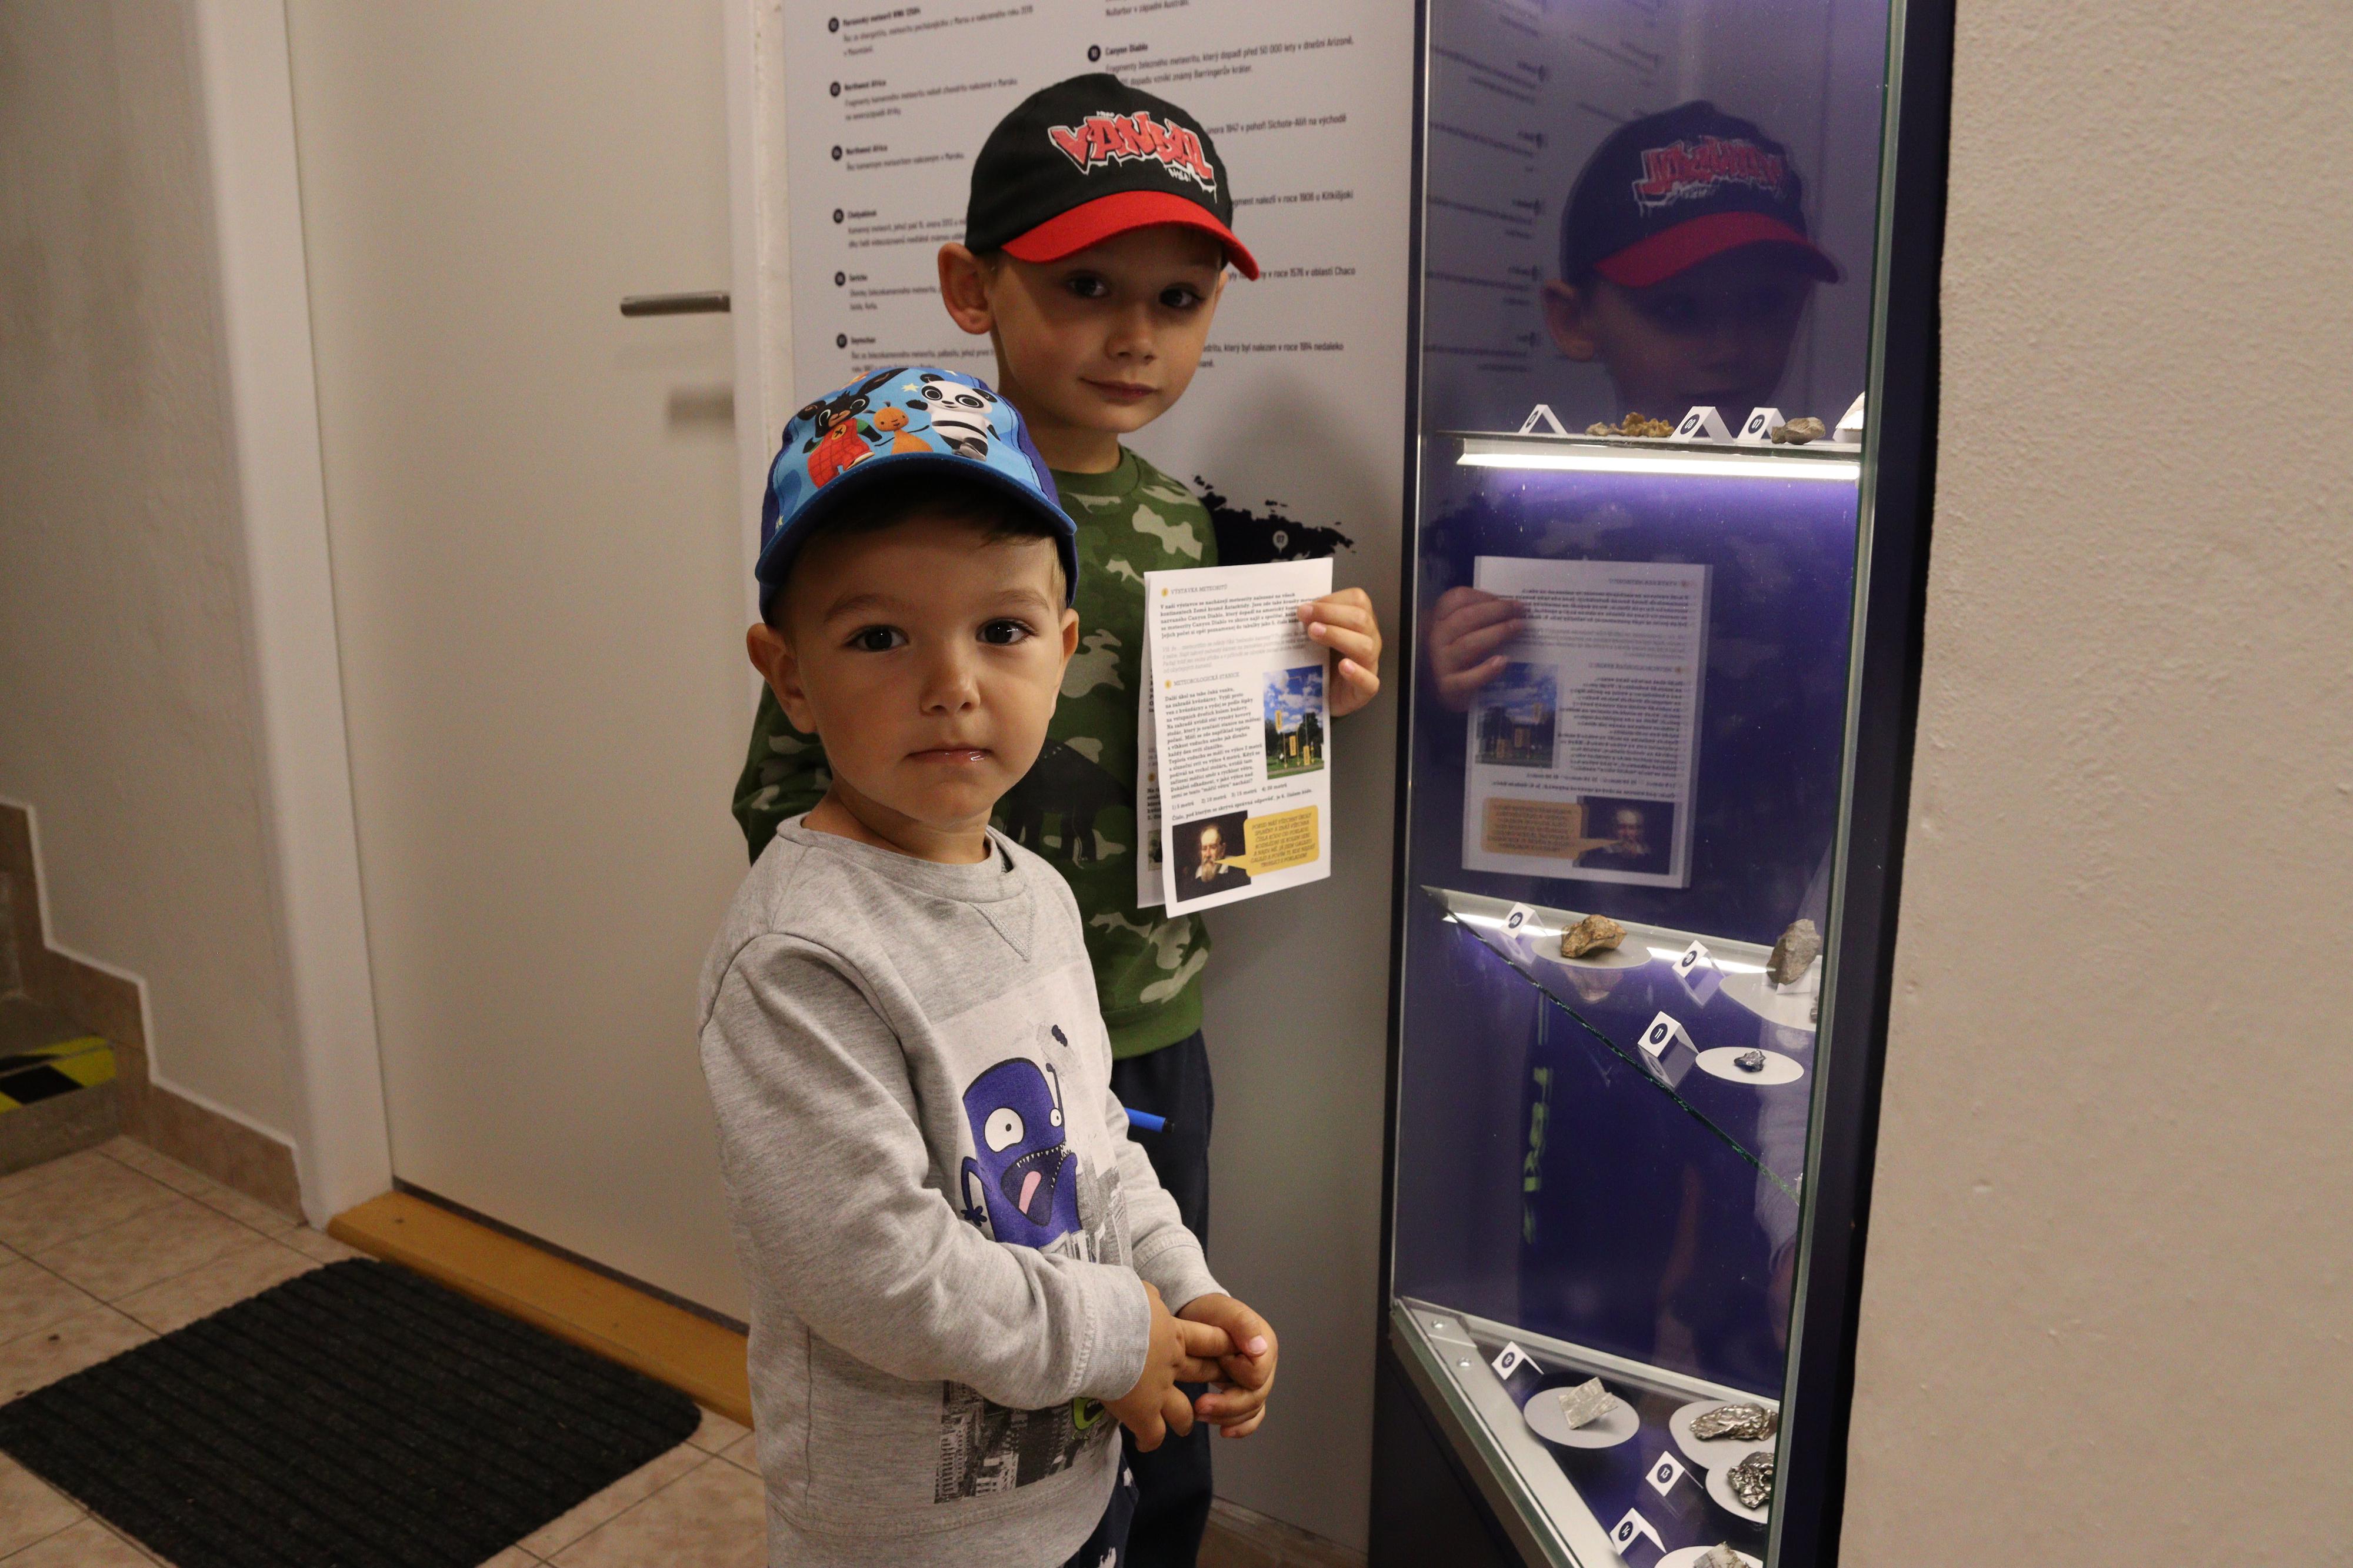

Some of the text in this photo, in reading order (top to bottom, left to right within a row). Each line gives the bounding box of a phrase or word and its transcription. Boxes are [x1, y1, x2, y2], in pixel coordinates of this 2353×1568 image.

[1048, 111, 1217, 187] VANDAL
[1685, 419, 1696, 429] 08
[1752, 420, 1762, 429] 07
[1654, 1028, 1664, 1039] 11
[1660, 1468, 1671, 1479] 13
[1622, 1526, 1629, 1536] 14
